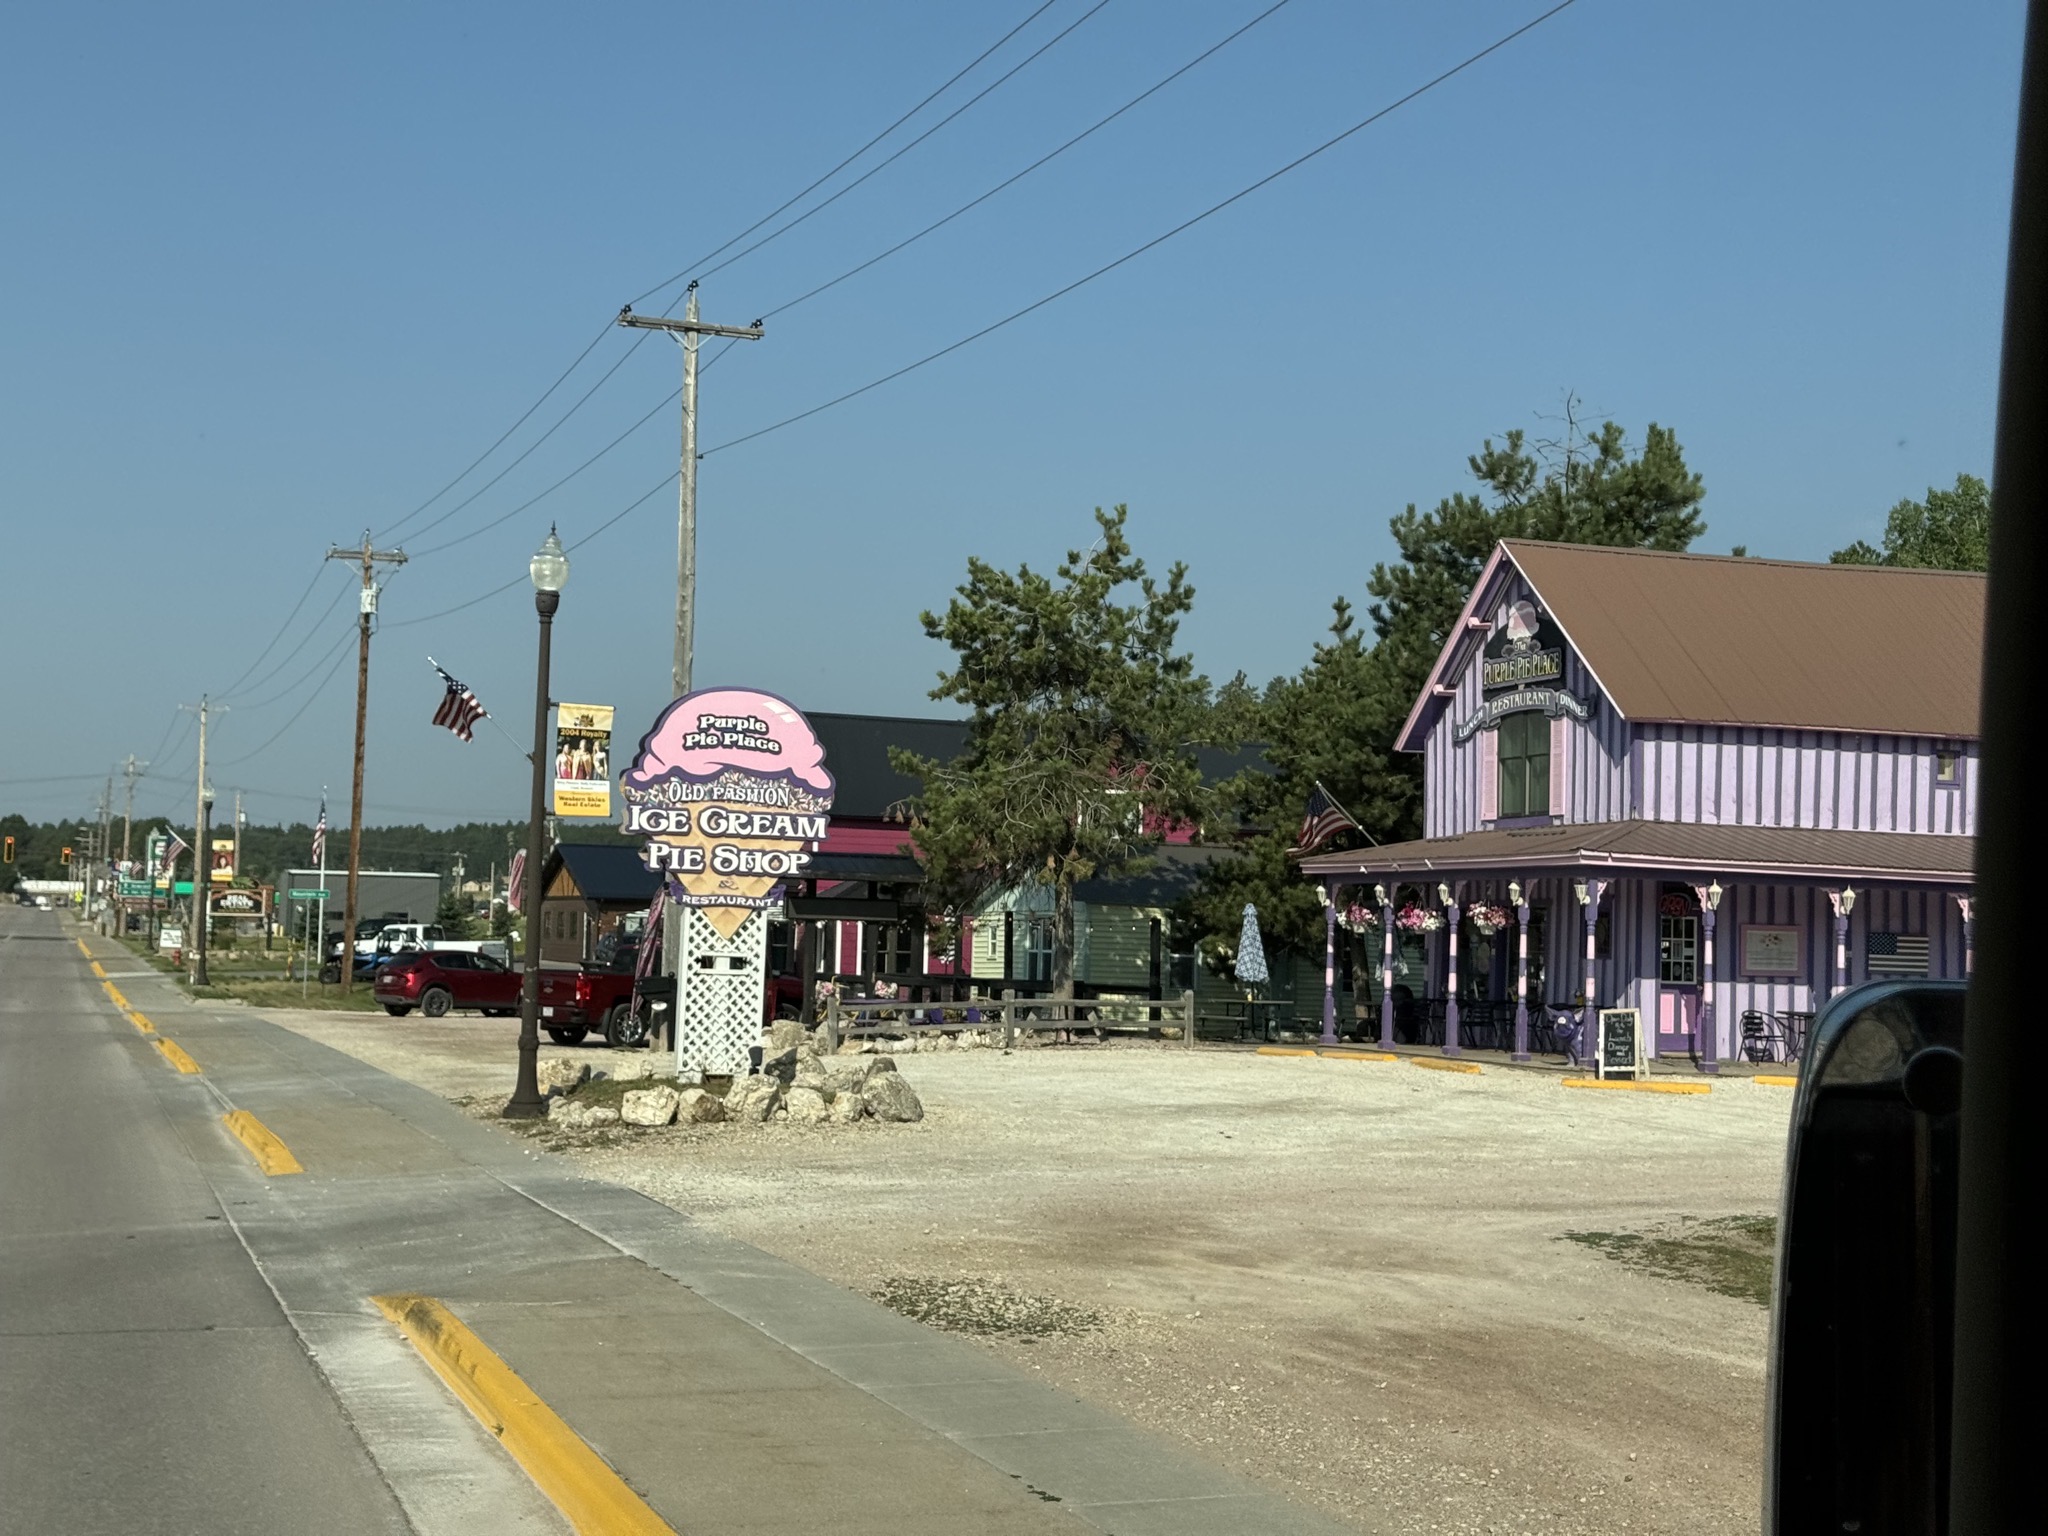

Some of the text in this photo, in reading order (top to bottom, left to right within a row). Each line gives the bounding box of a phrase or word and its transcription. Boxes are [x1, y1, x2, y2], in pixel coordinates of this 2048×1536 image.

[1483, 652, 1559, 685] PURPLE PIE PLACE
[698, 714, 768, 733] Purple
[1459, 691, 1588, 737] LUNCH RESTAURANT DINNER
[560, 728, 608, 739] 2004 Royalty
[684, 731, 780, 752] Pie Place
[668, 781, 791, 807] OLD FASHION
[628, 804, 827, 839] ICE CREAM
[647, 842, 811, 875] PIE SHOP
[219, 899, 255, 908] ESTATE
[682, 894, 775, 907] RESTAURANT
[1607, 1042, 1630, 1051] Dinner
[1608, 1032, 1632, 1042] Lunch
